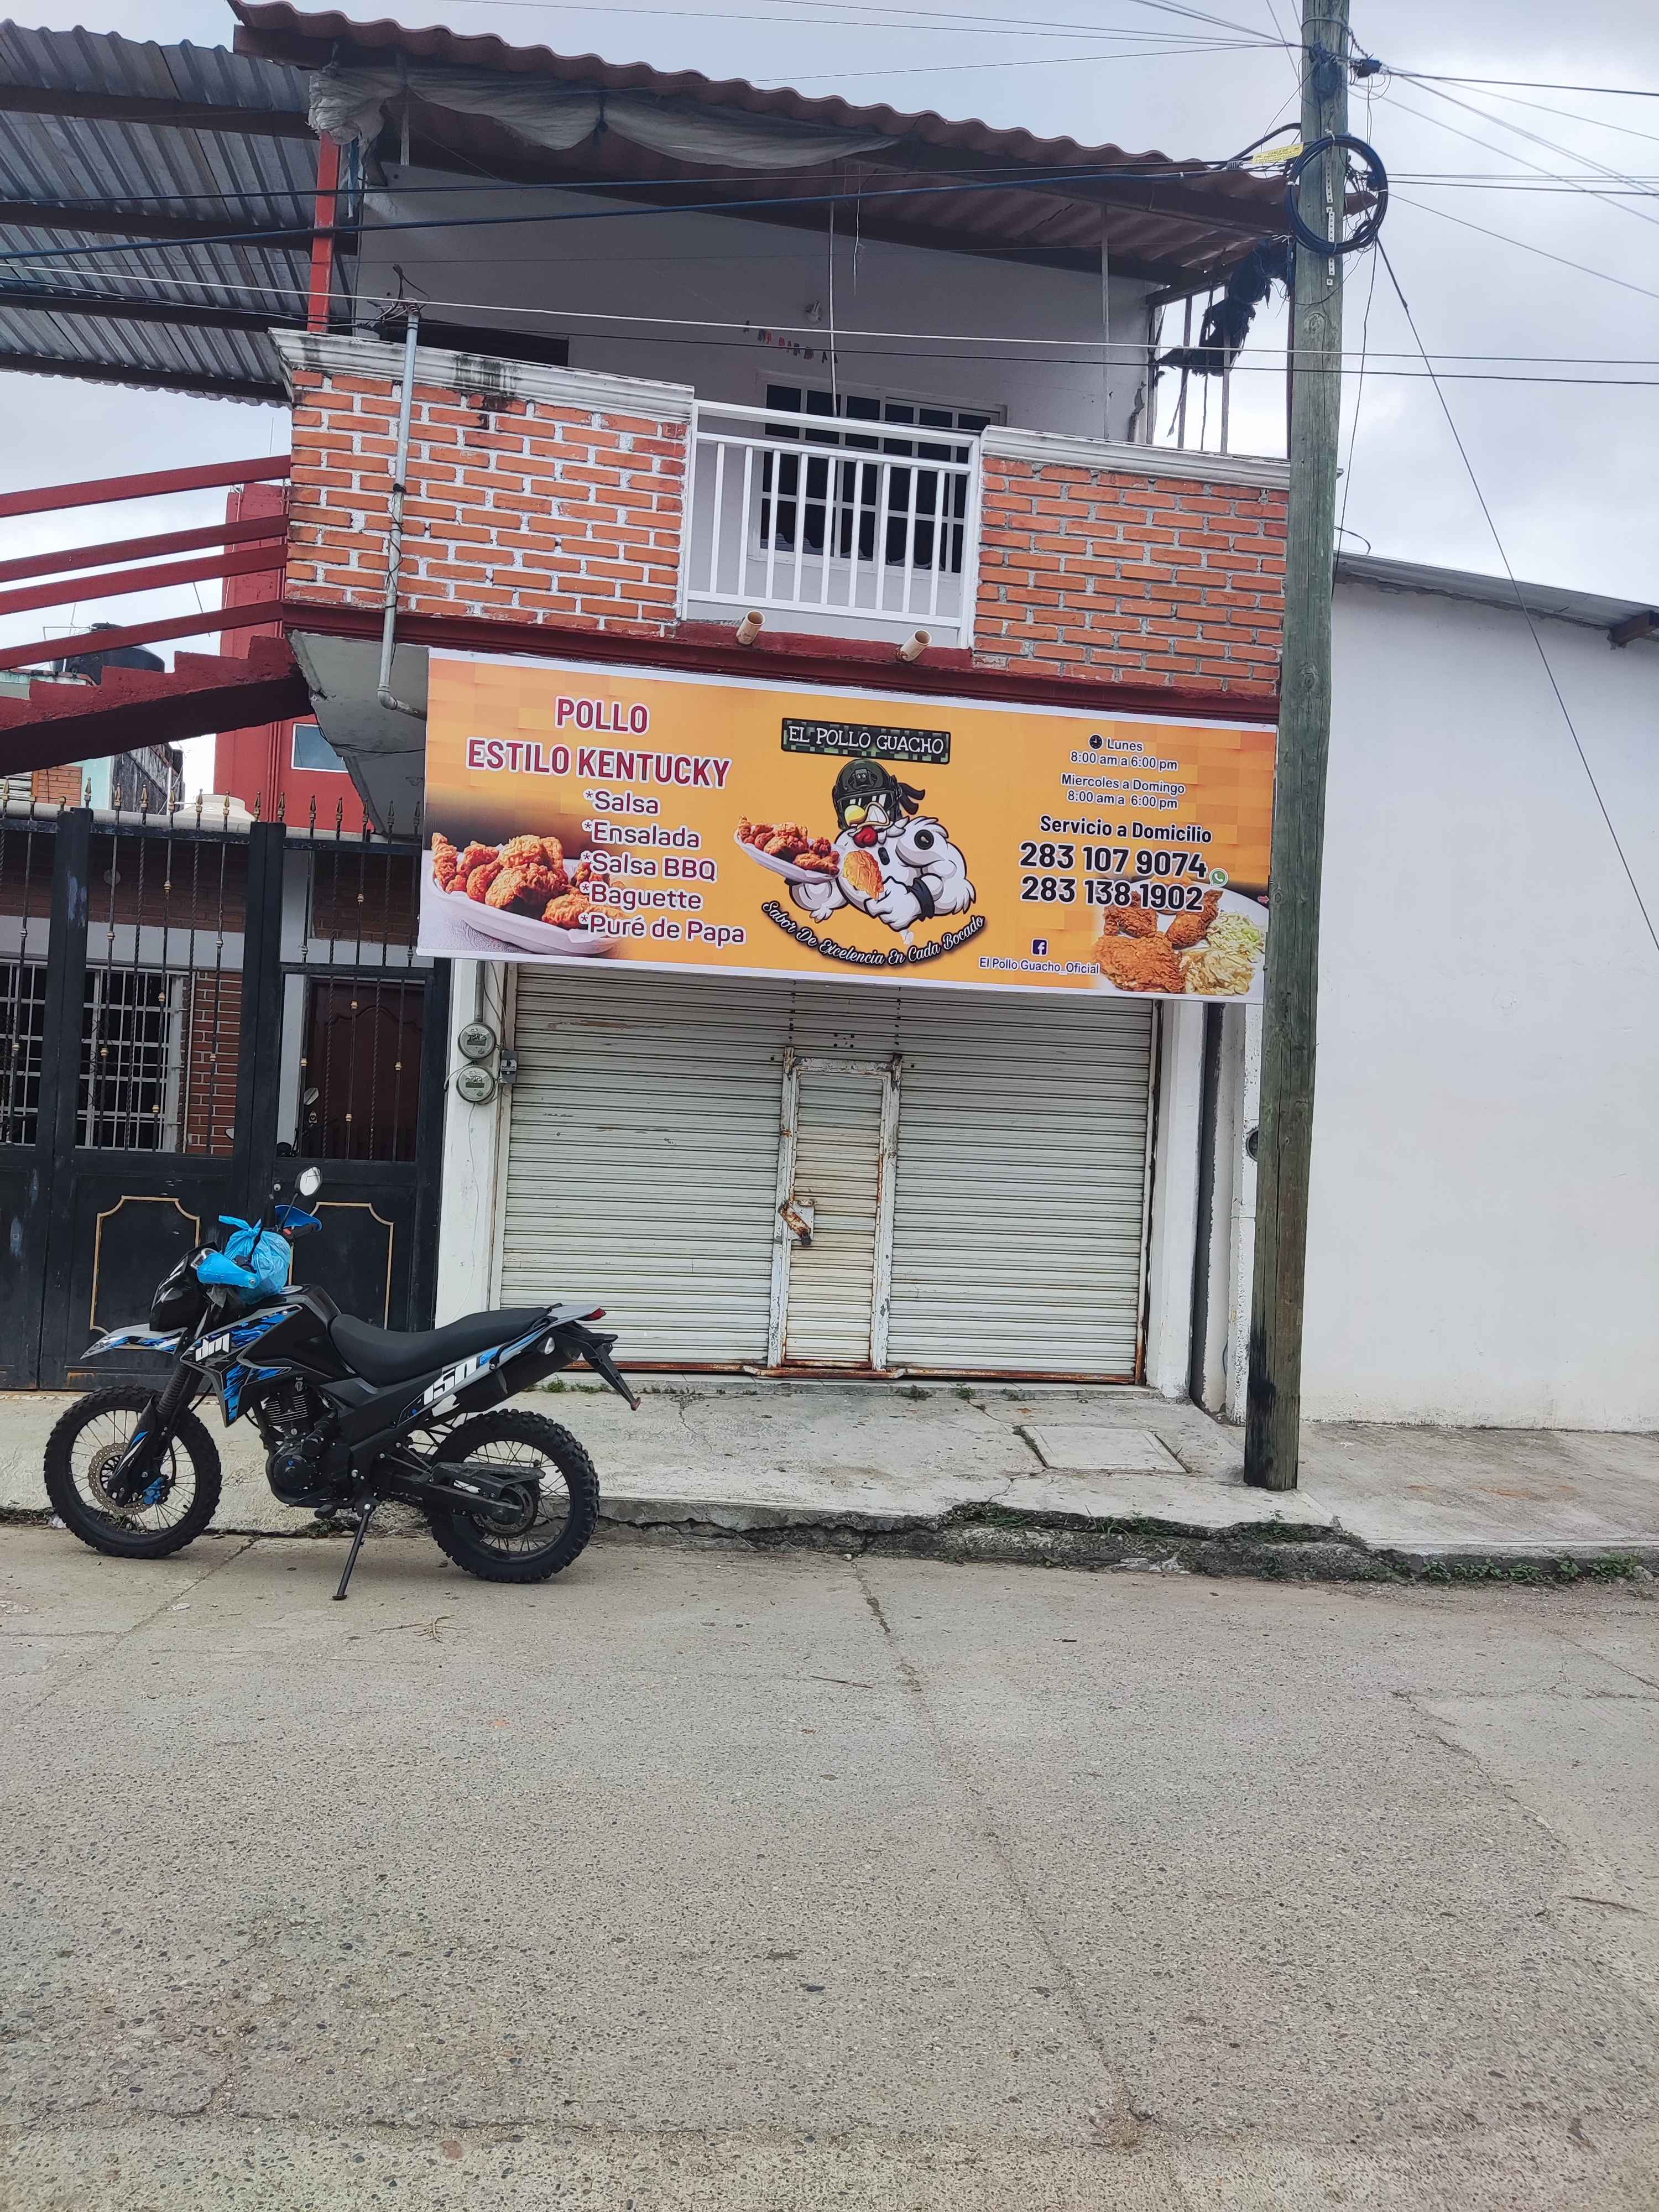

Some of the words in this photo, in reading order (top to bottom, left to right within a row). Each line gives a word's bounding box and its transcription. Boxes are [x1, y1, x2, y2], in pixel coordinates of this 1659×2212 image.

[556, 698, 649, 734] POLLO
[789, 726, 810, 743] EL
[816, 728, 871, 748] POLLO
[877, 735, 944, 754] GUACHO
[1107, 738, 1143, 752] Lunes
[469, 739, 570, 774] ESTILO
[578, 749, 731, 787] KENTUCKY
[1071, 751, 1097, 764] 8:00
[1099, 755, 1117, 765] am
[1121, 758, 1128, 766] a
[1131, 756, 1156, 768] 6:00
[1160, 760, 1178, 771] pm
[1062, 774, 1119, 789] Miercoles
[1123, 781, 1130, 790] a
[1134, 779, 1185, 795] Domingo
[1068, 790, 1094, 802] 8:00
[1097, 795, 1114, 804] am
[1131, 795, 1156, 807] 6:00
[1160, 800, 1178, 810] pm
[1040, 815, 1112, 837] Servicio
[1117, 825, 1128, 838] a
[1132, 822, 1212, 844] Domicilio
[665, 859, 716, 881] BBQ
[1020, 842, 1074, 869] 283
[1083, 847, 1129, 872] 107
[1136, 851, 1206, 878] 9074
[1021, 877, 1076, 902] 283
[1084, 880, 1130, 906] 138
[1140, 884, 1203, 910] 1902
[653, 919, 680, 938] de
[688, 922, 744, 946] Papa
[763, 902, 796, 932] Sabor
[796, 928, 817, 946] De
[819, 940, 885, 964] Excelencia
[888, 950, 905, 964] En
[908, 942, 941, 962] Cada
[942, 916, 984, 950] Bocado
[979, 958, 989, 968] El
[993, 958, 1018, 969] Pollo
[1021, 960, 1099, 974] Guacho_Oficial
[424, 1357, 477, 1405] 150
